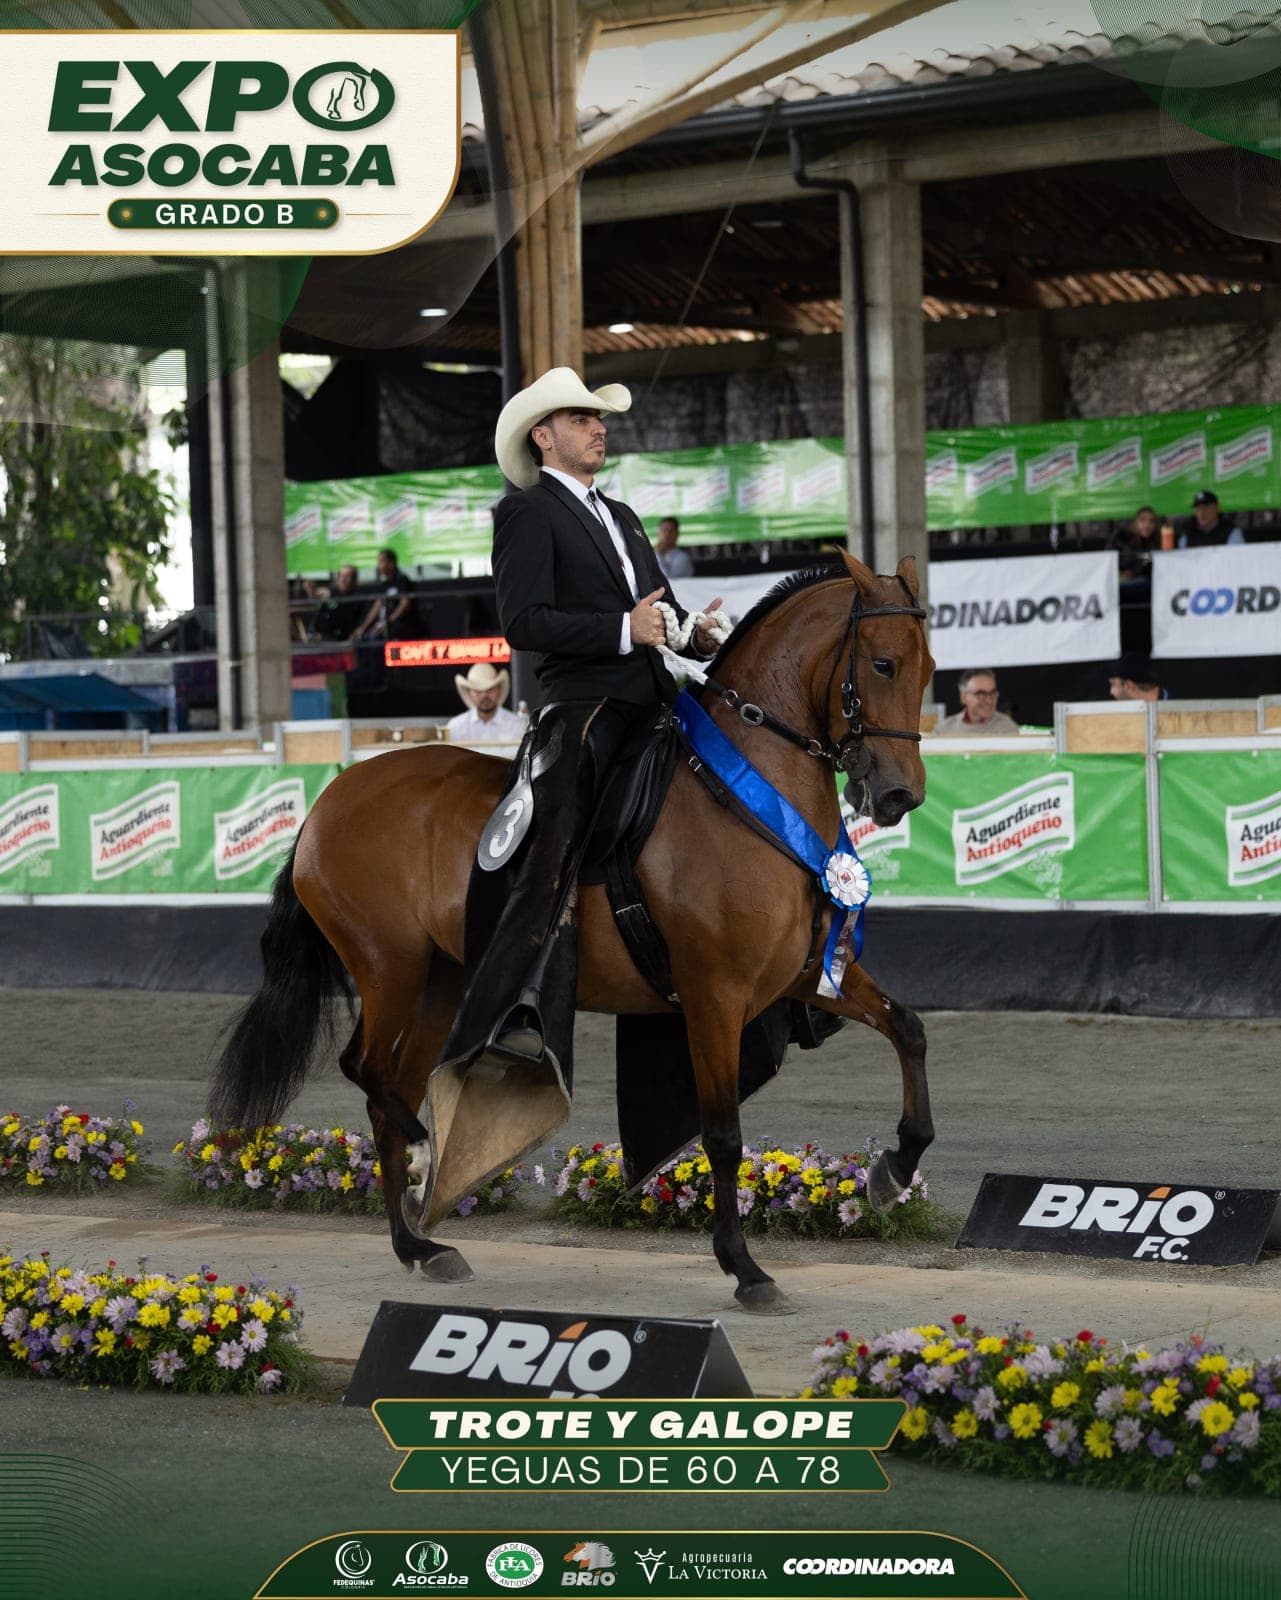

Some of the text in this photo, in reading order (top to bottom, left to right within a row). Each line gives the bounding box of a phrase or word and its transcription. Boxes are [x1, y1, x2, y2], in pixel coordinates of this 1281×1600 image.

[489, 798, 525, 858] 3
[965, 796, 1062, 844] Aguardiente
[967, 812, 1063, 862] Antioqueño
[1132, 1235, 1191, 1261] F.C.
